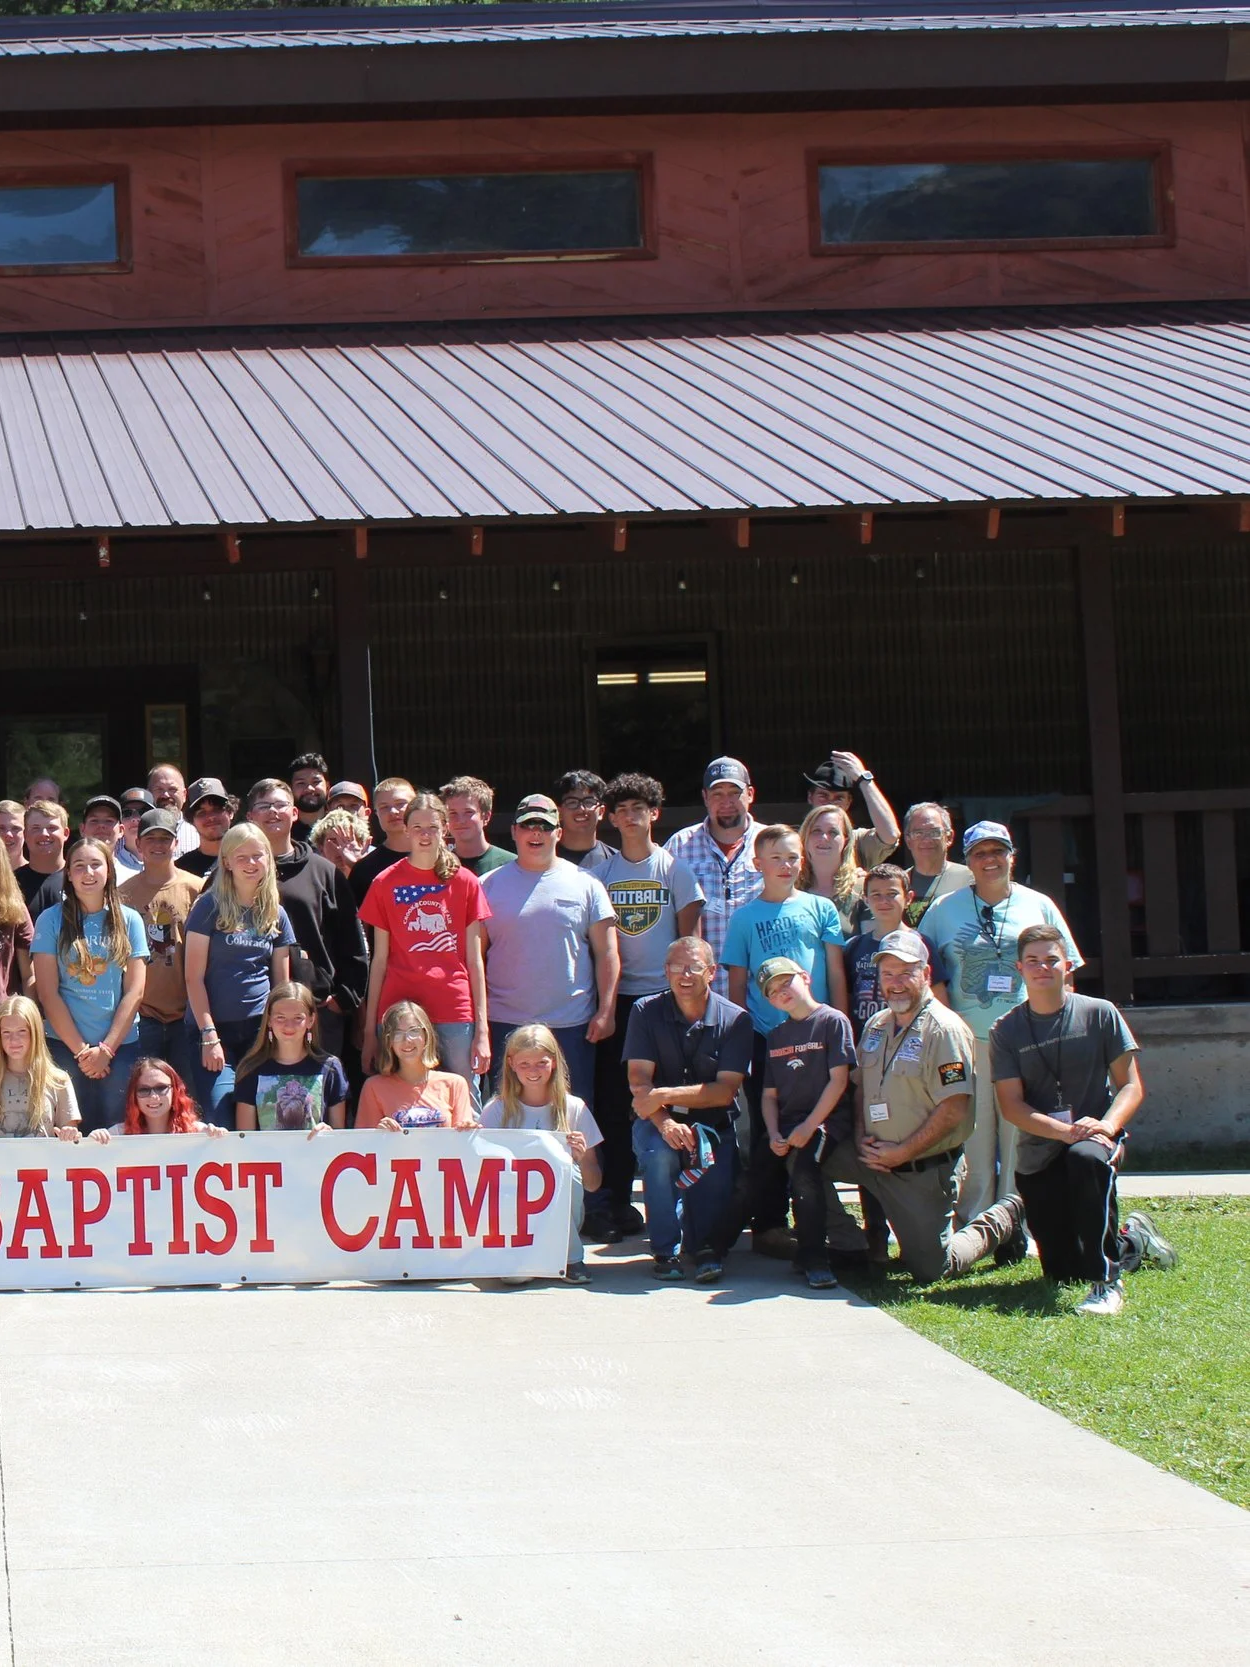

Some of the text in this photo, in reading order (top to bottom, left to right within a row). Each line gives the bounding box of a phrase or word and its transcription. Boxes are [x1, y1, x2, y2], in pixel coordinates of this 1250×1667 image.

[611, 889, 667, 905] OOTBALL
[755, 913, 807, 939] HARDES
[225, 933, 270, 949] Colorado
[321, 1152, 554, 1251] CAMP
